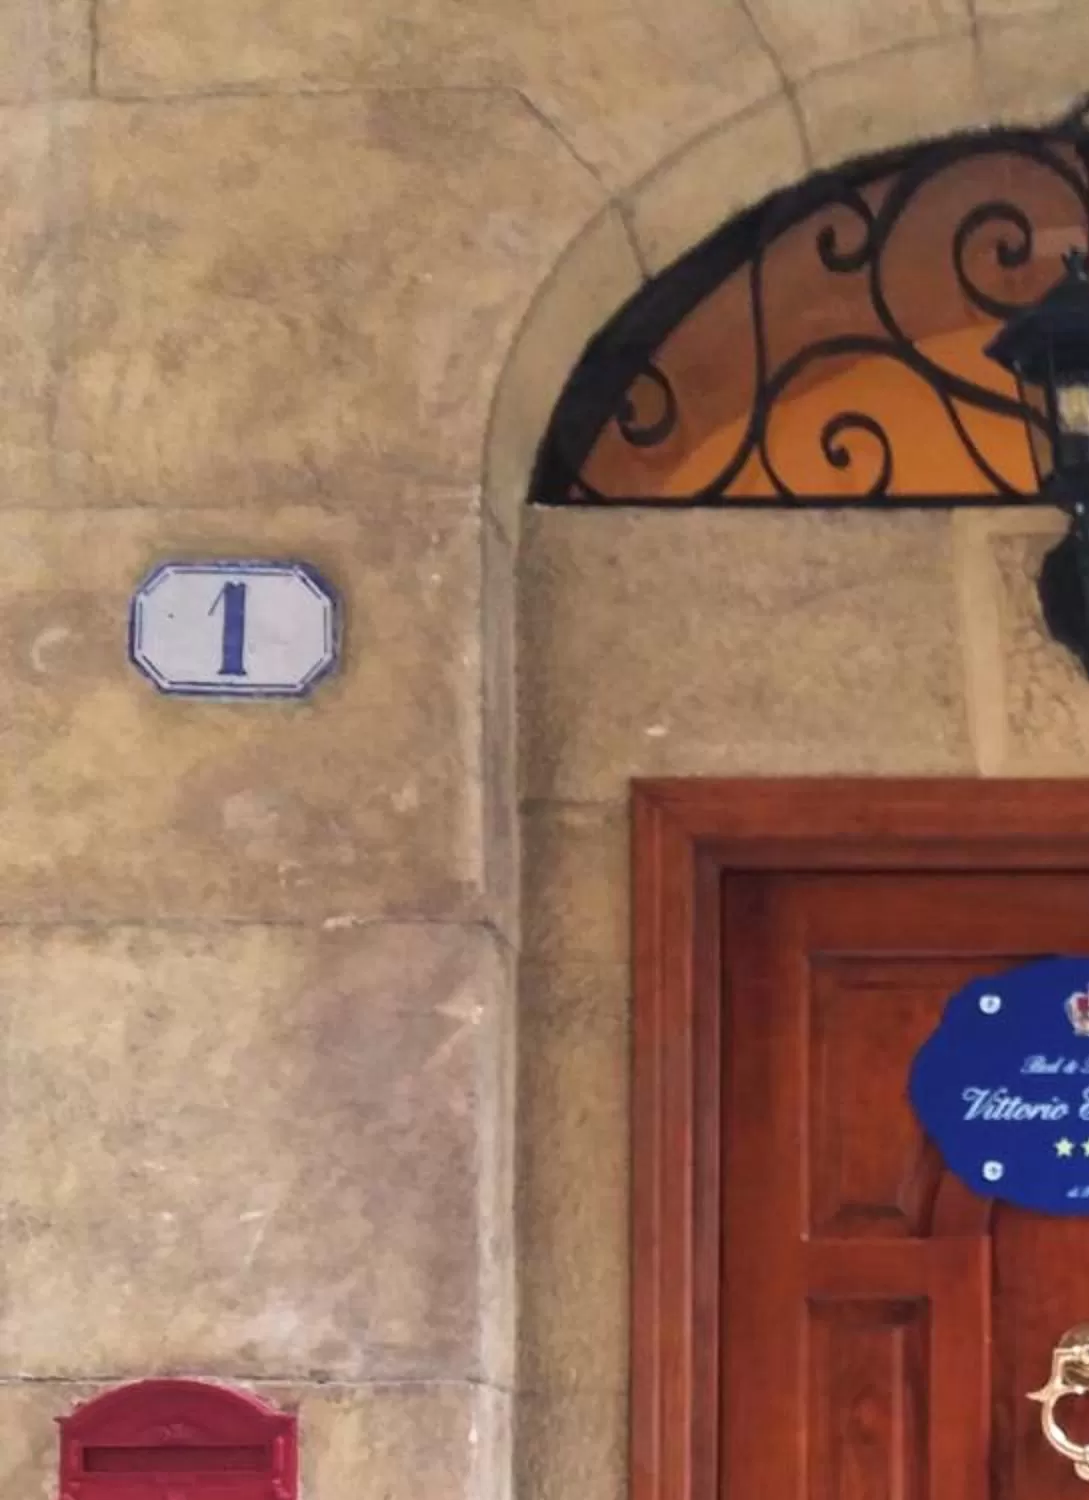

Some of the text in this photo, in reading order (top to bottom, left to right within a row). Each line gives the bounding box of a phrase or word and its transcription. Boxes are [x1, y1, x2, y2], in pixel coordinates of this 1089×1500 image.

[208, 581, 247, 676] 1
[1020, 1055, 1064, 1074] Bed
[961, 1087, 1069, 1121] Vittorio
